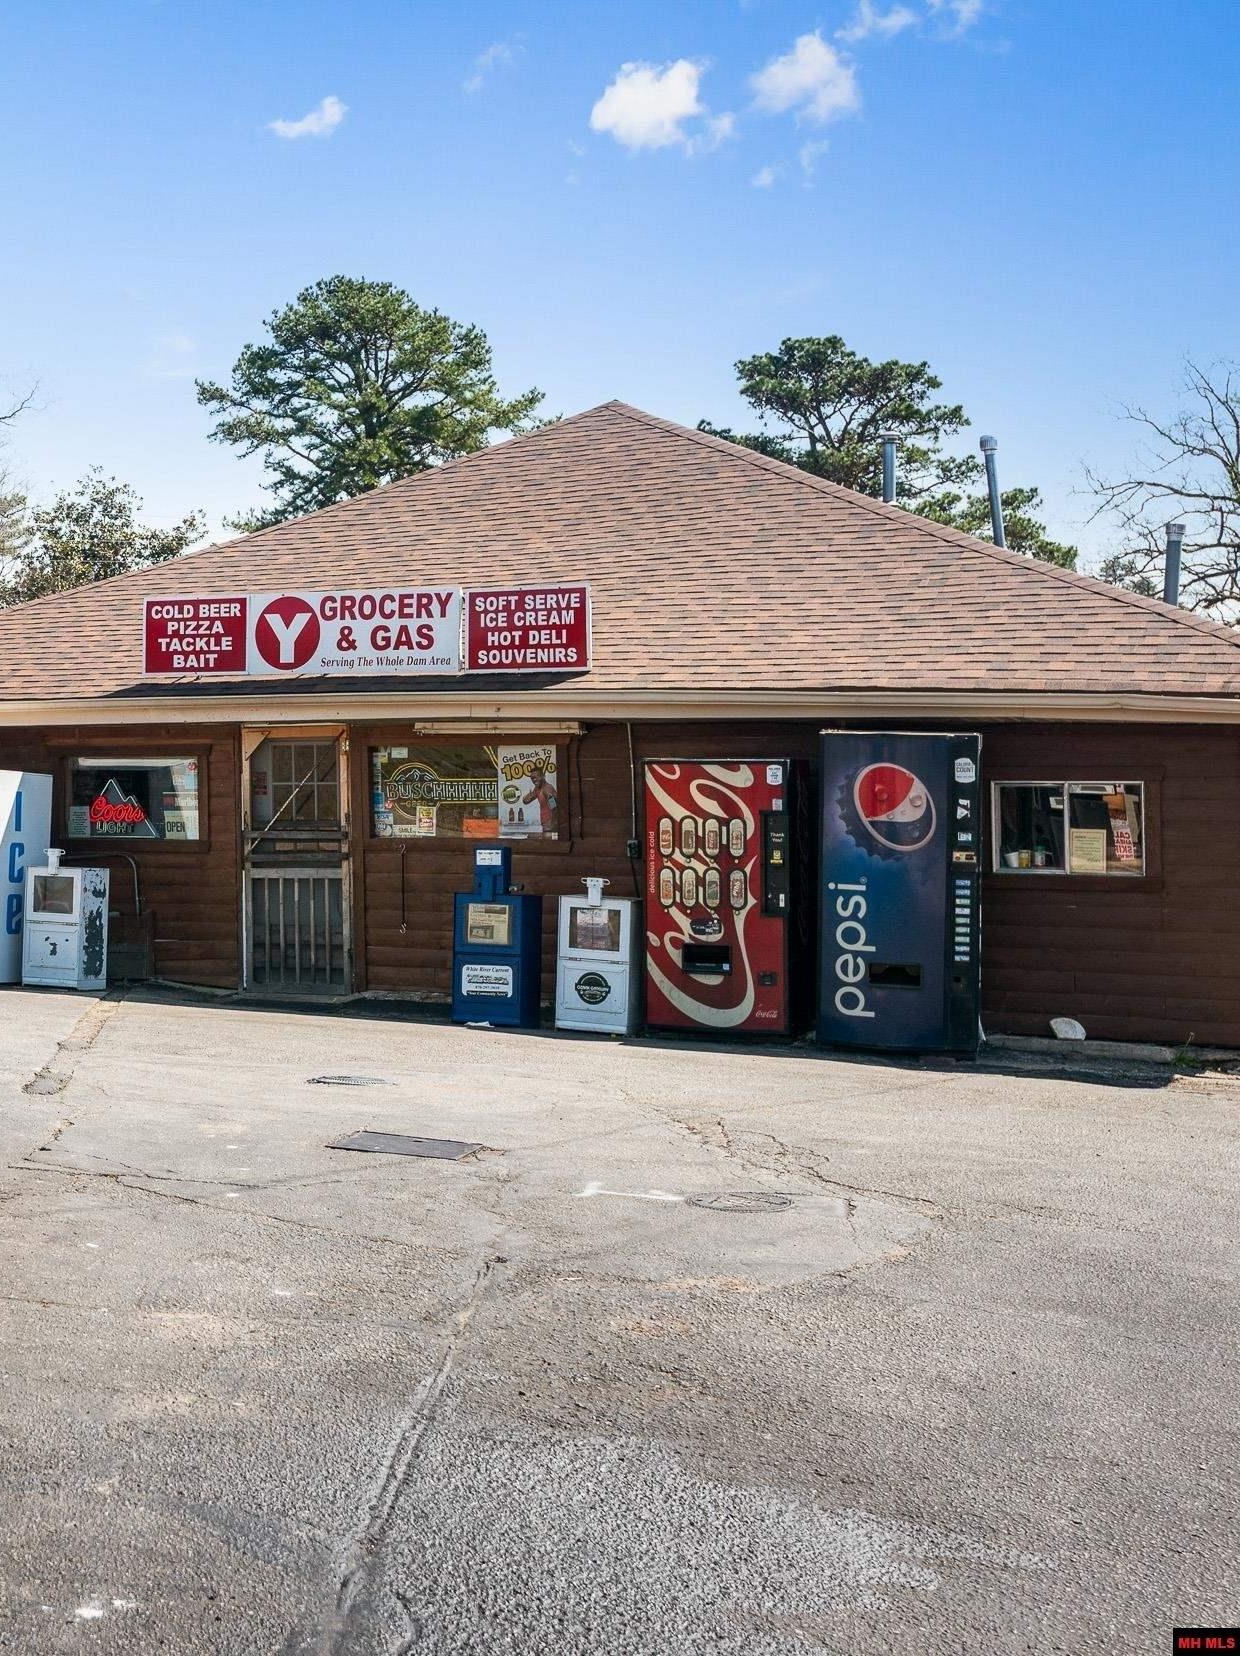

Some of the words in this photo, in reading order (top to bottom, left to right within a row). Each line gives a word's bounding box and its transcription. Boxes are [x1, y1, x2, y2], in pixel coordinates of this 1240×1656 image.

[319, 592, 454, 621] GROCERY
[475, 595, 518, 611] SOFT
[524, 593, 580, 609] SERVE
[151, 605, 194, 619] COLD
[199, 603, 241, 618] BEER
[480, 612, 507, 627] ICE
[513, 609, 575, 626] CREAM
[167, 620, 224, 635] PIZZA
[158, 636, 233, 651] TACKLE
[263, 612, 313, 664] Y
[336, 626, 358, 651] &
[370, 623, 435, 651] GAS
[487, 630, 522, 646] HOT
[528, 629, 567, 645] DELI
[173, 653, 218, 668] BAIT
[320, 657, 355, 669] Serving
[357, 656, 374, 667] The
[376, 656, 400, 667] Whole
[403, 655, 426, 666] Dam
[429, 655, 451, 666] Area
[478, 647, 578, 665] SOUVENIRS
[502, 755, 518, 764] Get
[518, 750, 540, 760] Back
[501, 755, 557, 781] 100%
[90, 796, 145, 823] Coors
[96, 821, 135, 834] LIGHT
[166, 821, 185, 832] OPEN
[828, 882, 877, 1018] pepsi
